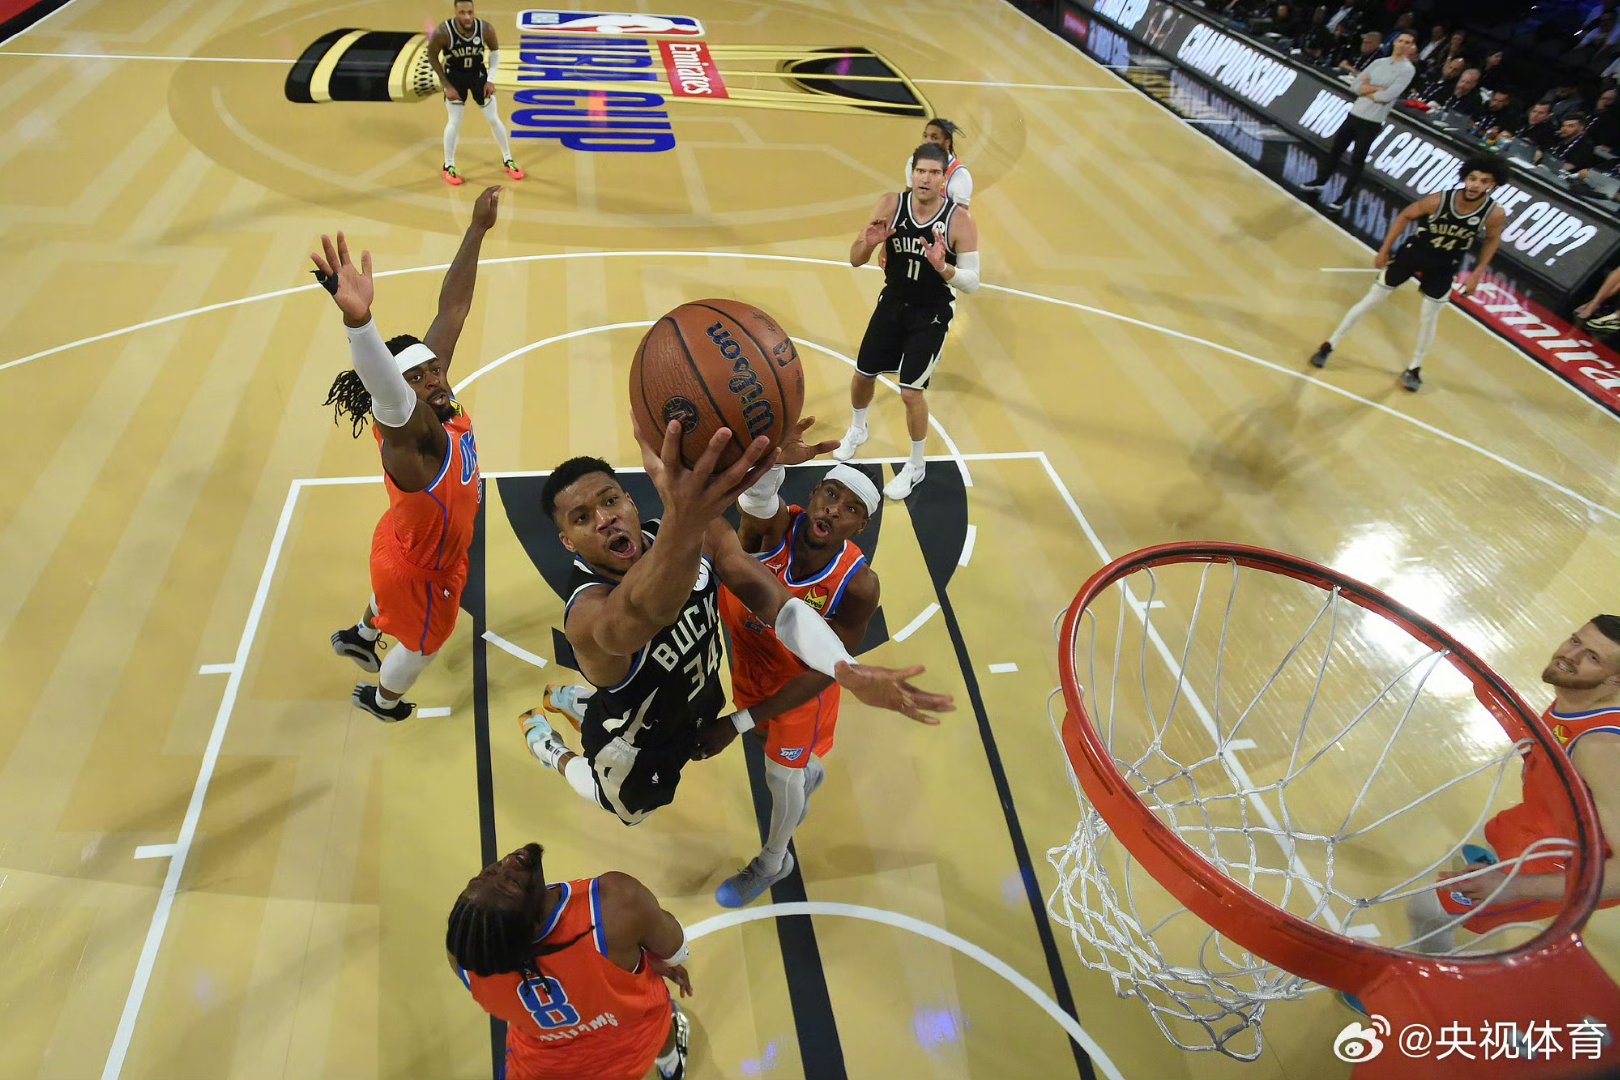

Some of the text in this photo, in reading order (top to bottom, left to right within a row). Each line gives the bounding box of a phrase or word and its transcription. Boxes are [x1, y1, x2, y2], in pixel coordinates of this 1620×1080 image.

[511, 35, 676, 152] NBA CUP
[668, 43, 712, 95] Emirates
[1177, 23, 1298, 108] CHAMPIONSHIP
[1298, 89, 1354, 139] WHO
[1373, 131, 1465, 195] CAPTUR
[1500, 201, 1598, 266] CUP?
[1429, 223, 1476, 239] BUCKS
[1430, 236, 1458, 251] 44
[907, 258, 921, 281] 11
[706, 320, 775, 441] Wilson
[652, 592, 717, 672] BUCK
[683, 633, 719, 702] 34
[516, 975, 581, 1030] 8
